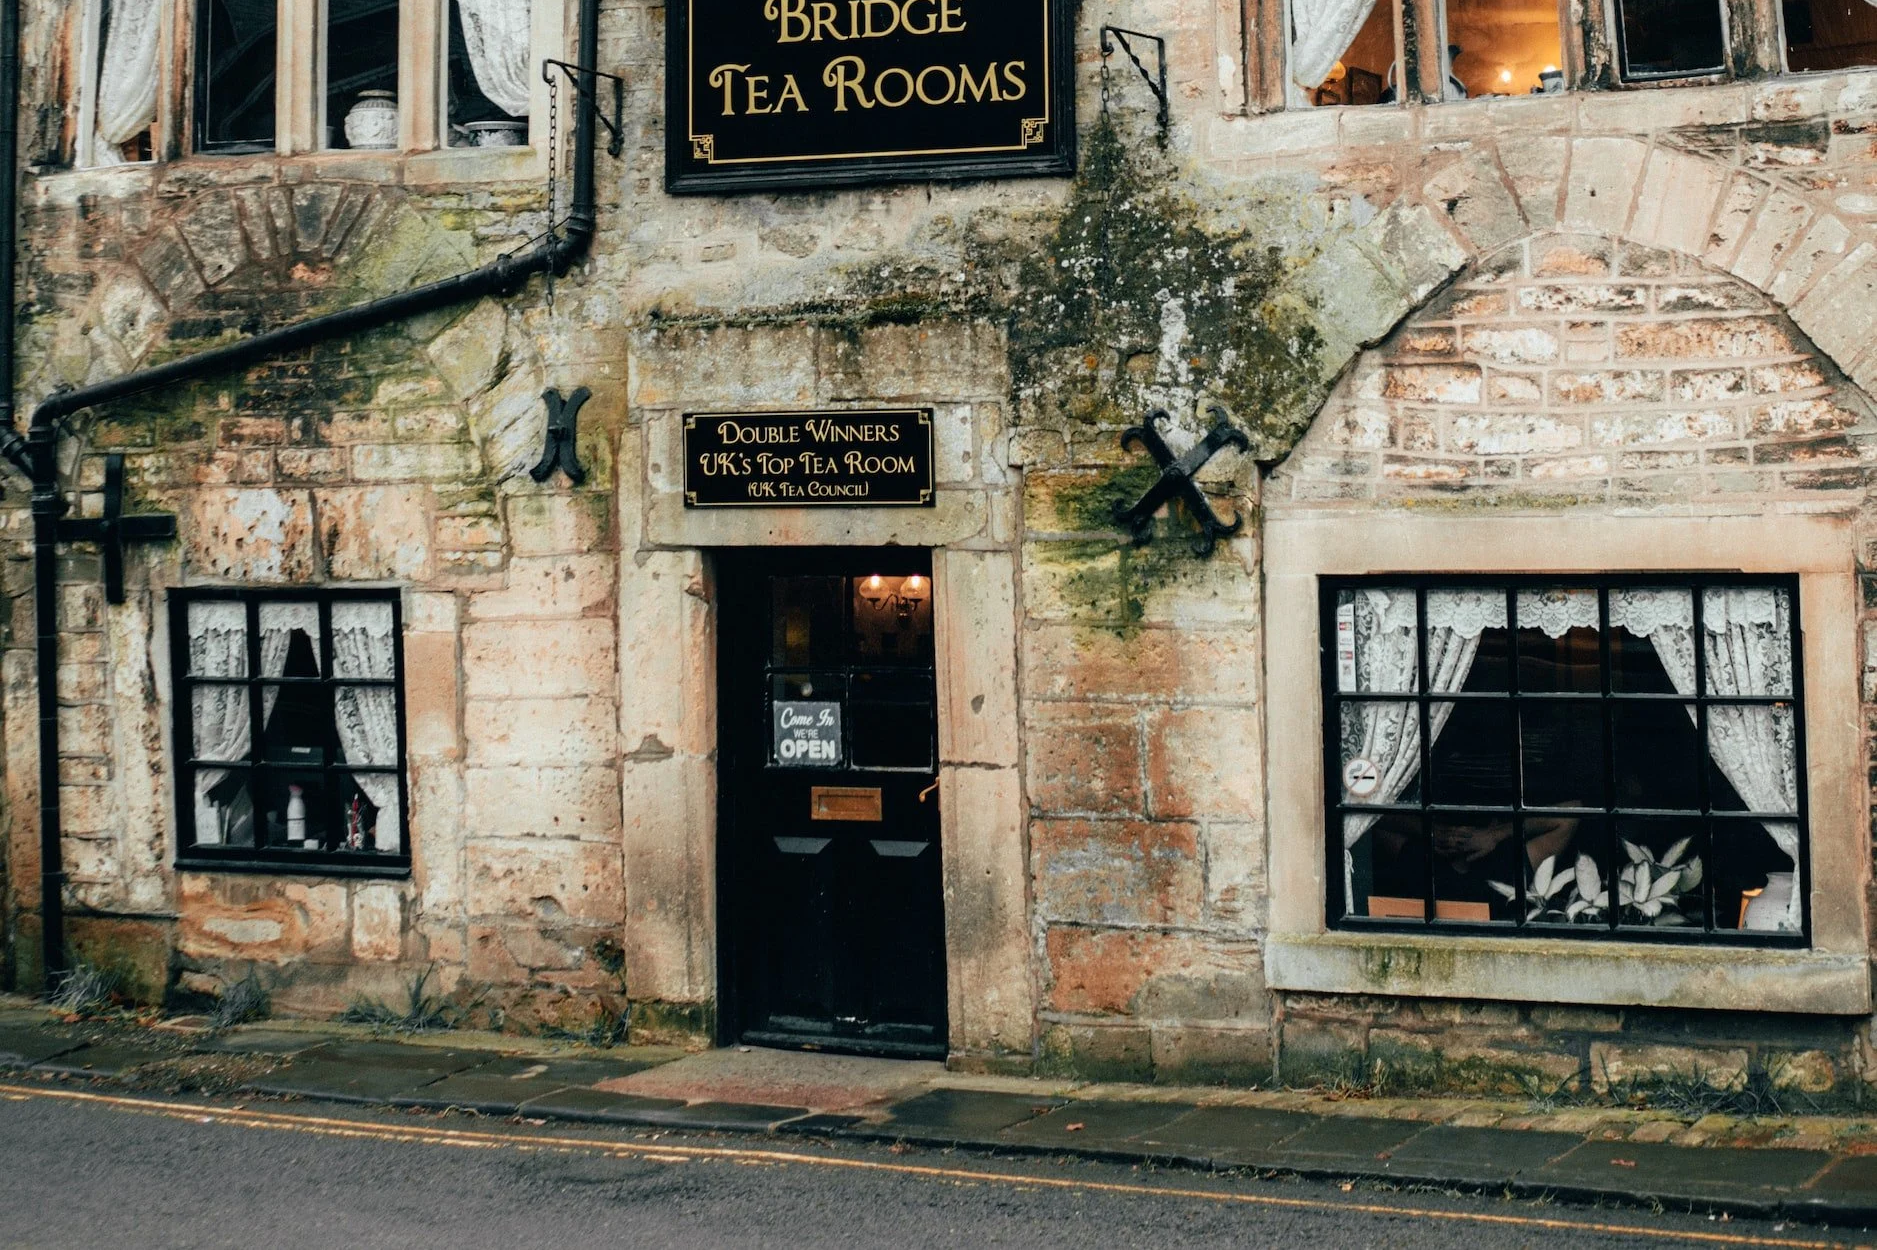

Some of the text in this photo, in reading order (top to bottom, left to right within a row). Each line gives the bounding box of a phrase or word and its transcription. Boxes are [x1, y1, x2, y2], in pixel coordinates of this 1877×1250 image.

[708, 55, 1027, 116] TEA ROOMS
[717, 419, 900, 445] DOUBLE WINNERS
[756, 452, 795, 475] TOP
[798, 451, 839, 475] TEA
[843, 450, 916, 475] ROOM
[778, 481, 805, 497] TEA
[807, 480, 869, 497] COUNCIL)
[780, 707, 835, 728] Come In
[793, 729, 819, 739] WE'RE
[780, 739, 836, 759] OPEN
